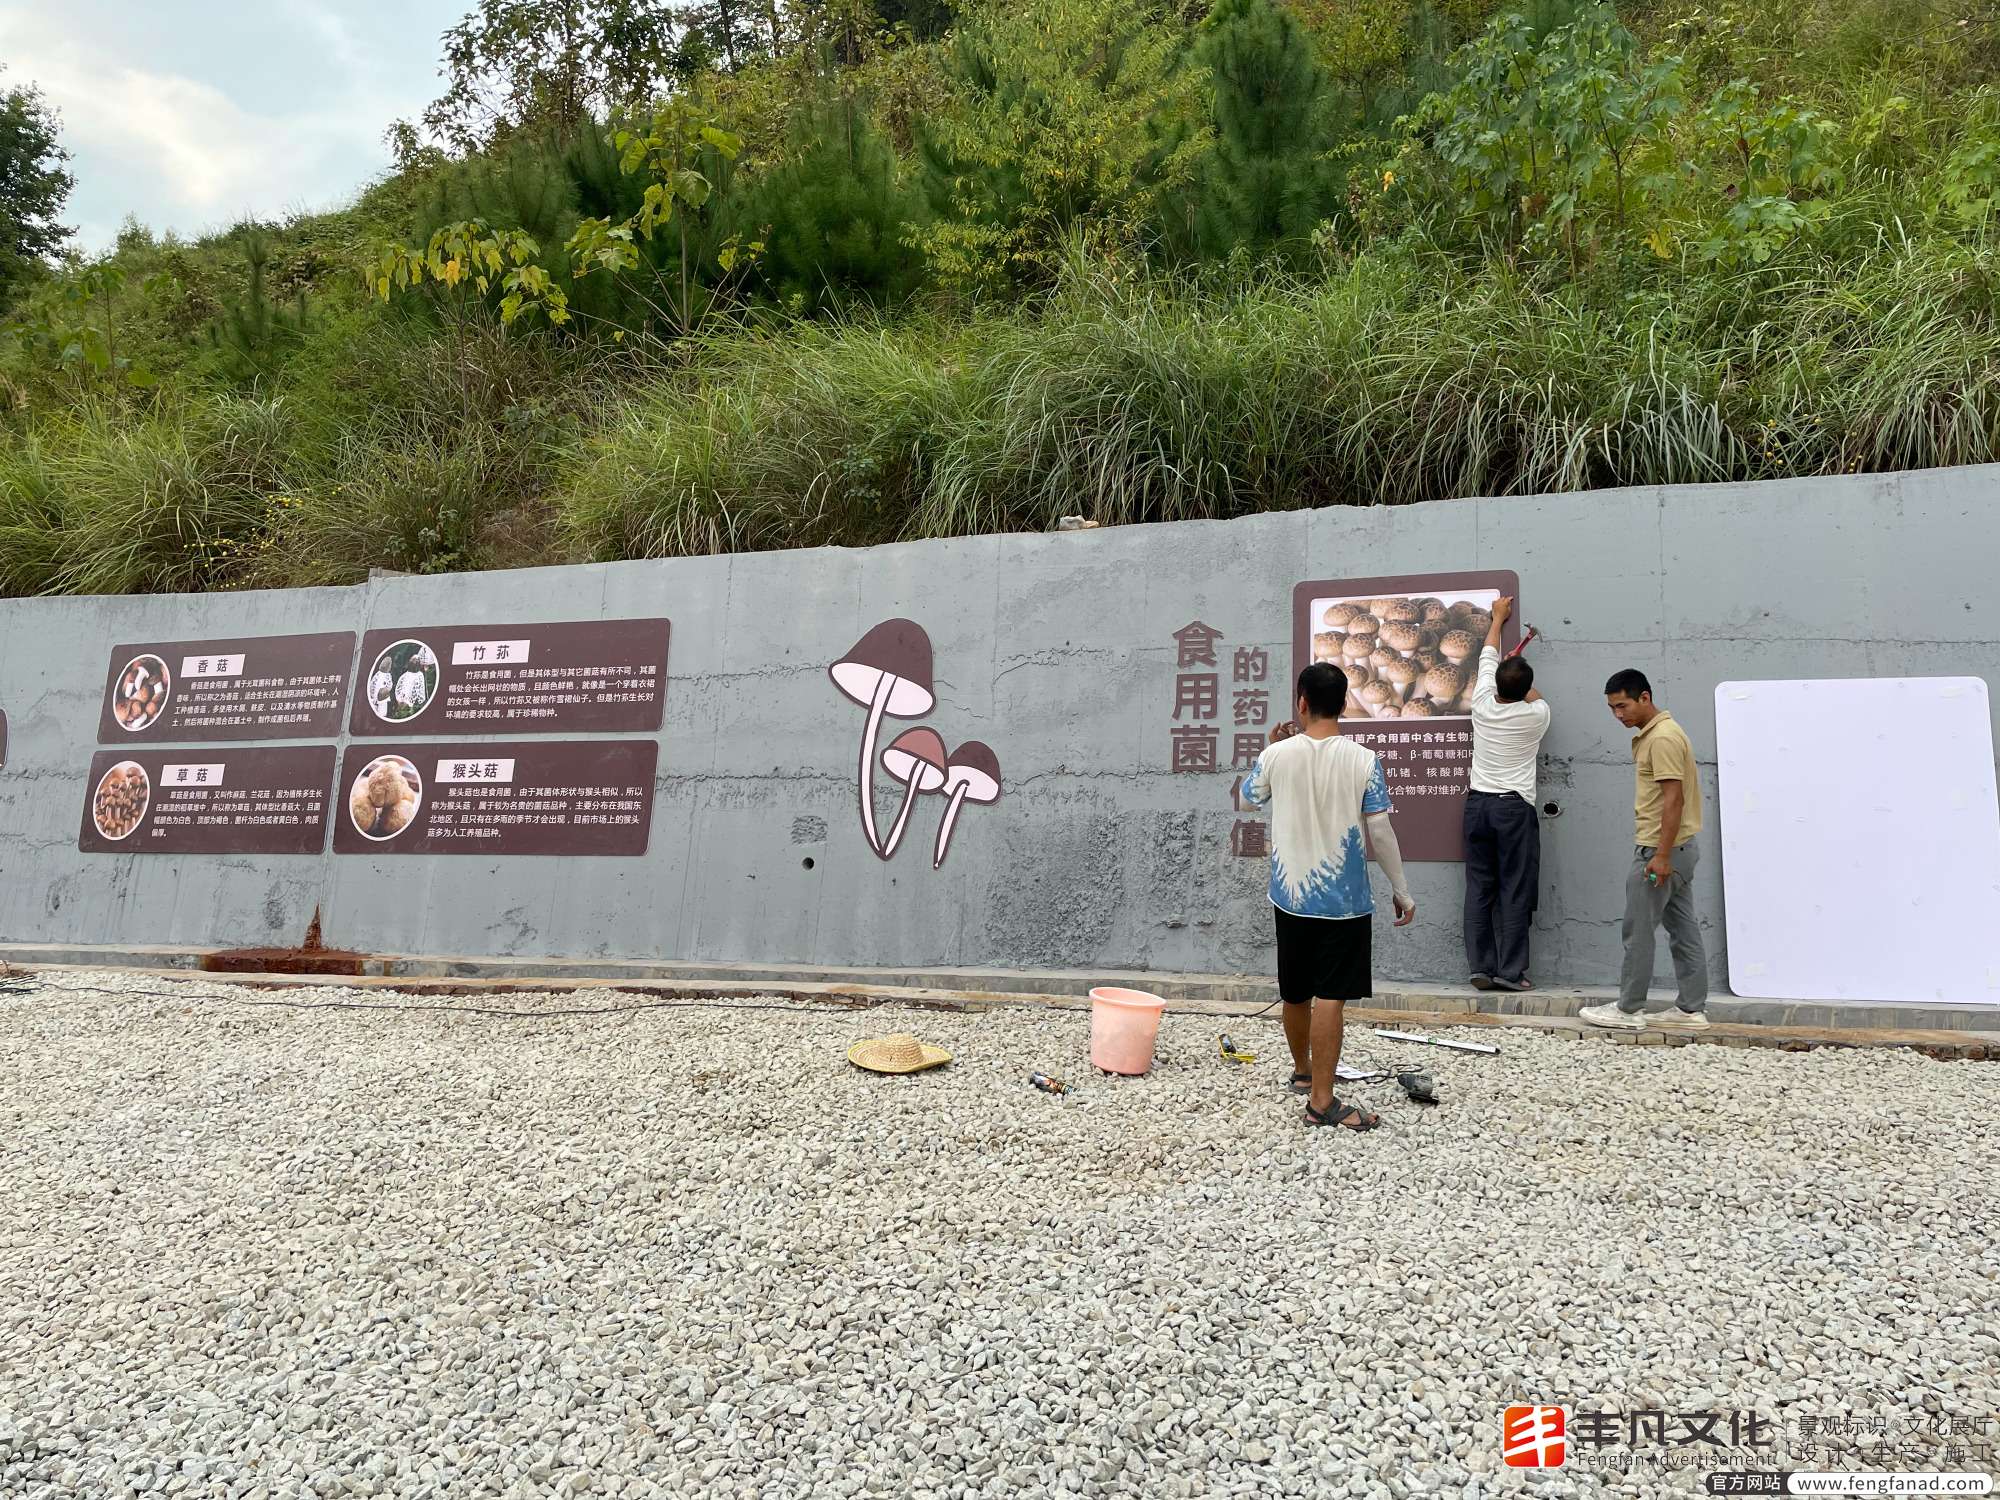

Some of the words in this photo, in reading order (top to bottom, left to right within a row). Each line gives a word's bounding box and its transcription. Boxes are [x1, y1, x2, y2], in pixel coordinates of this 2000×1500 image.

[472, 645, 510, 661] 竹荪
[197, 659, 229, 673] 香菇
[1170, 620, 1225, 774] 食用菌
[176, 768, 209, 782] 草菇
[452, 763, 498, 779] 猴头菇
